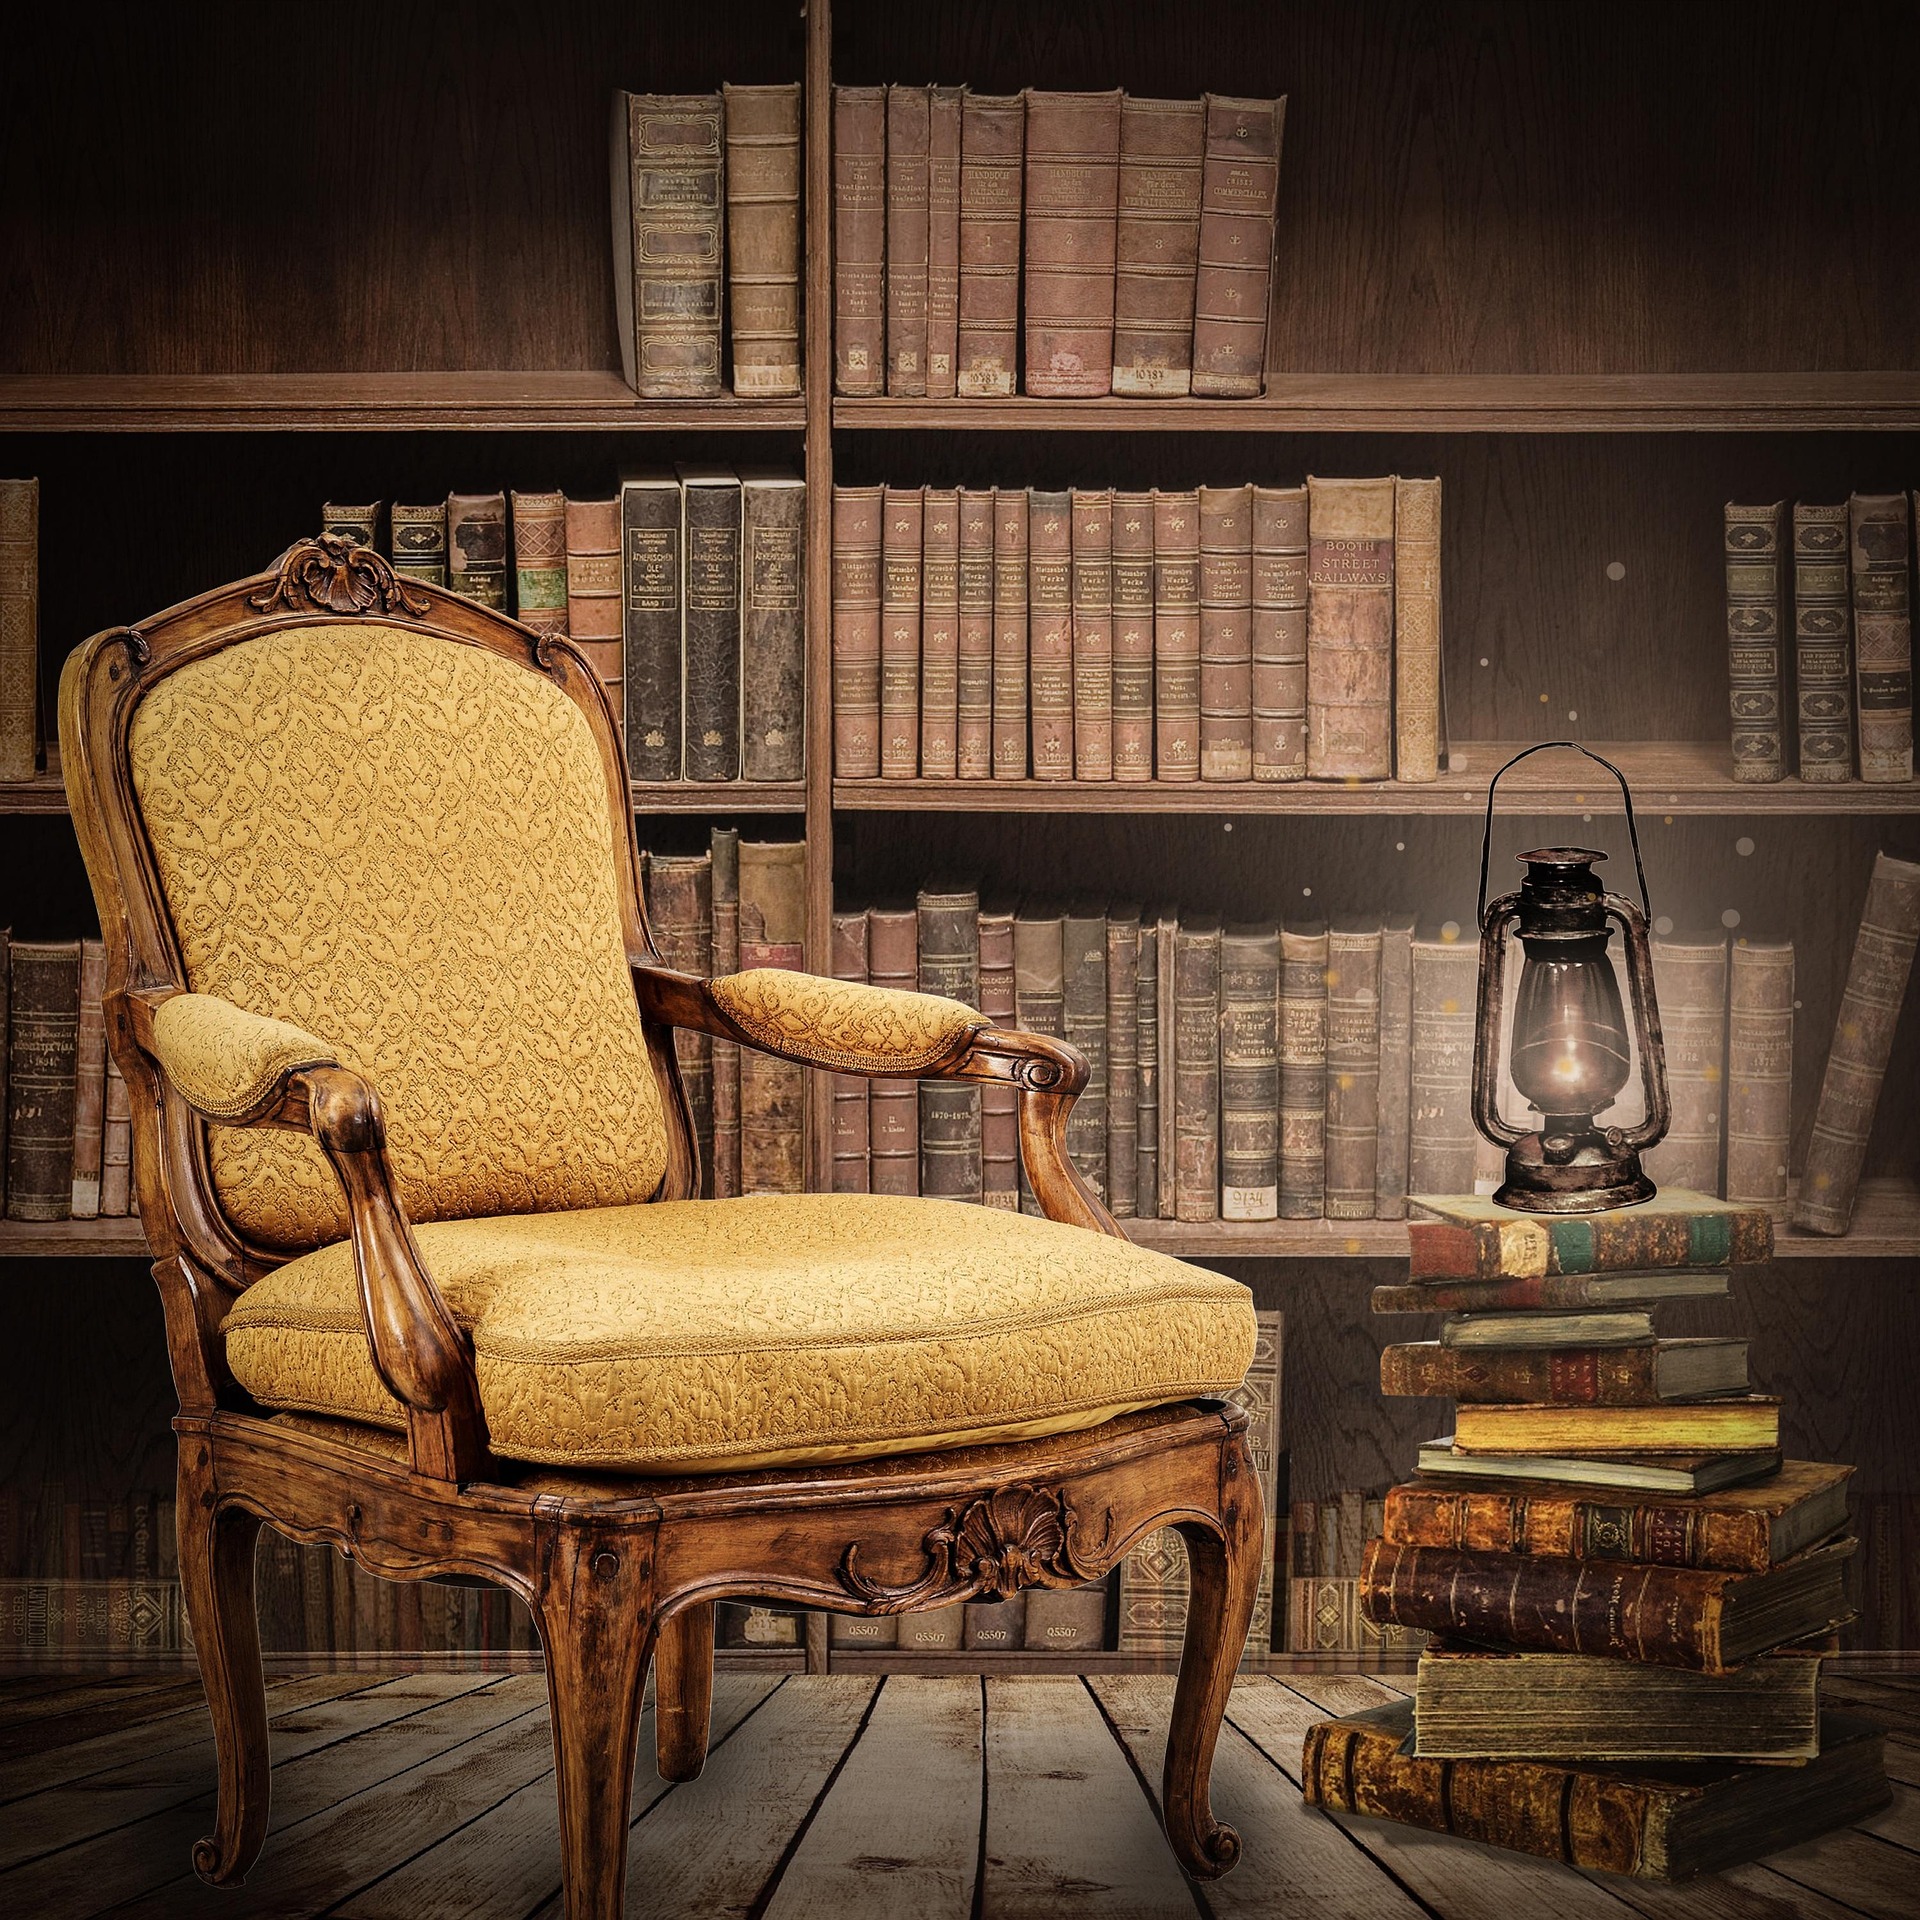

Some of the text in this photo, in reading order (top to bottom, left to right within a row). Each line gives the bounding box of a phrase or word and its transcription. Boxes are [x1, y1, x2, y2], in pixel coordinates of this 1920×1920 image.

[985, 235, 992, 248] 1
[1066, 233, 1074, 245] 2
[1154, 239, 1164, 250] 3
[1326, 541, 1375, 552] BOOTH
[1321, 557, 1380, 569] STREET
[889, 574, 915, 582] Werke
[1166, 576, 1189, 584] Werke
[1313, 571, 1387, 583] RAILWAYS
[28, 1586, 48, 1647] DICTIONARY
[76, 1594, 87, 1637] GERMAN
[88, 1608, 96, 1626] AND
[96, 1596, 108, 1636] ENGLISH
[848, 1625, 880, 1636] Q5507
[976, 1629, 1008, 1641] Q5507
[1045, 1626, 1079, 1638] Q5507
[914, 1631, 947, 1643] Q5507
